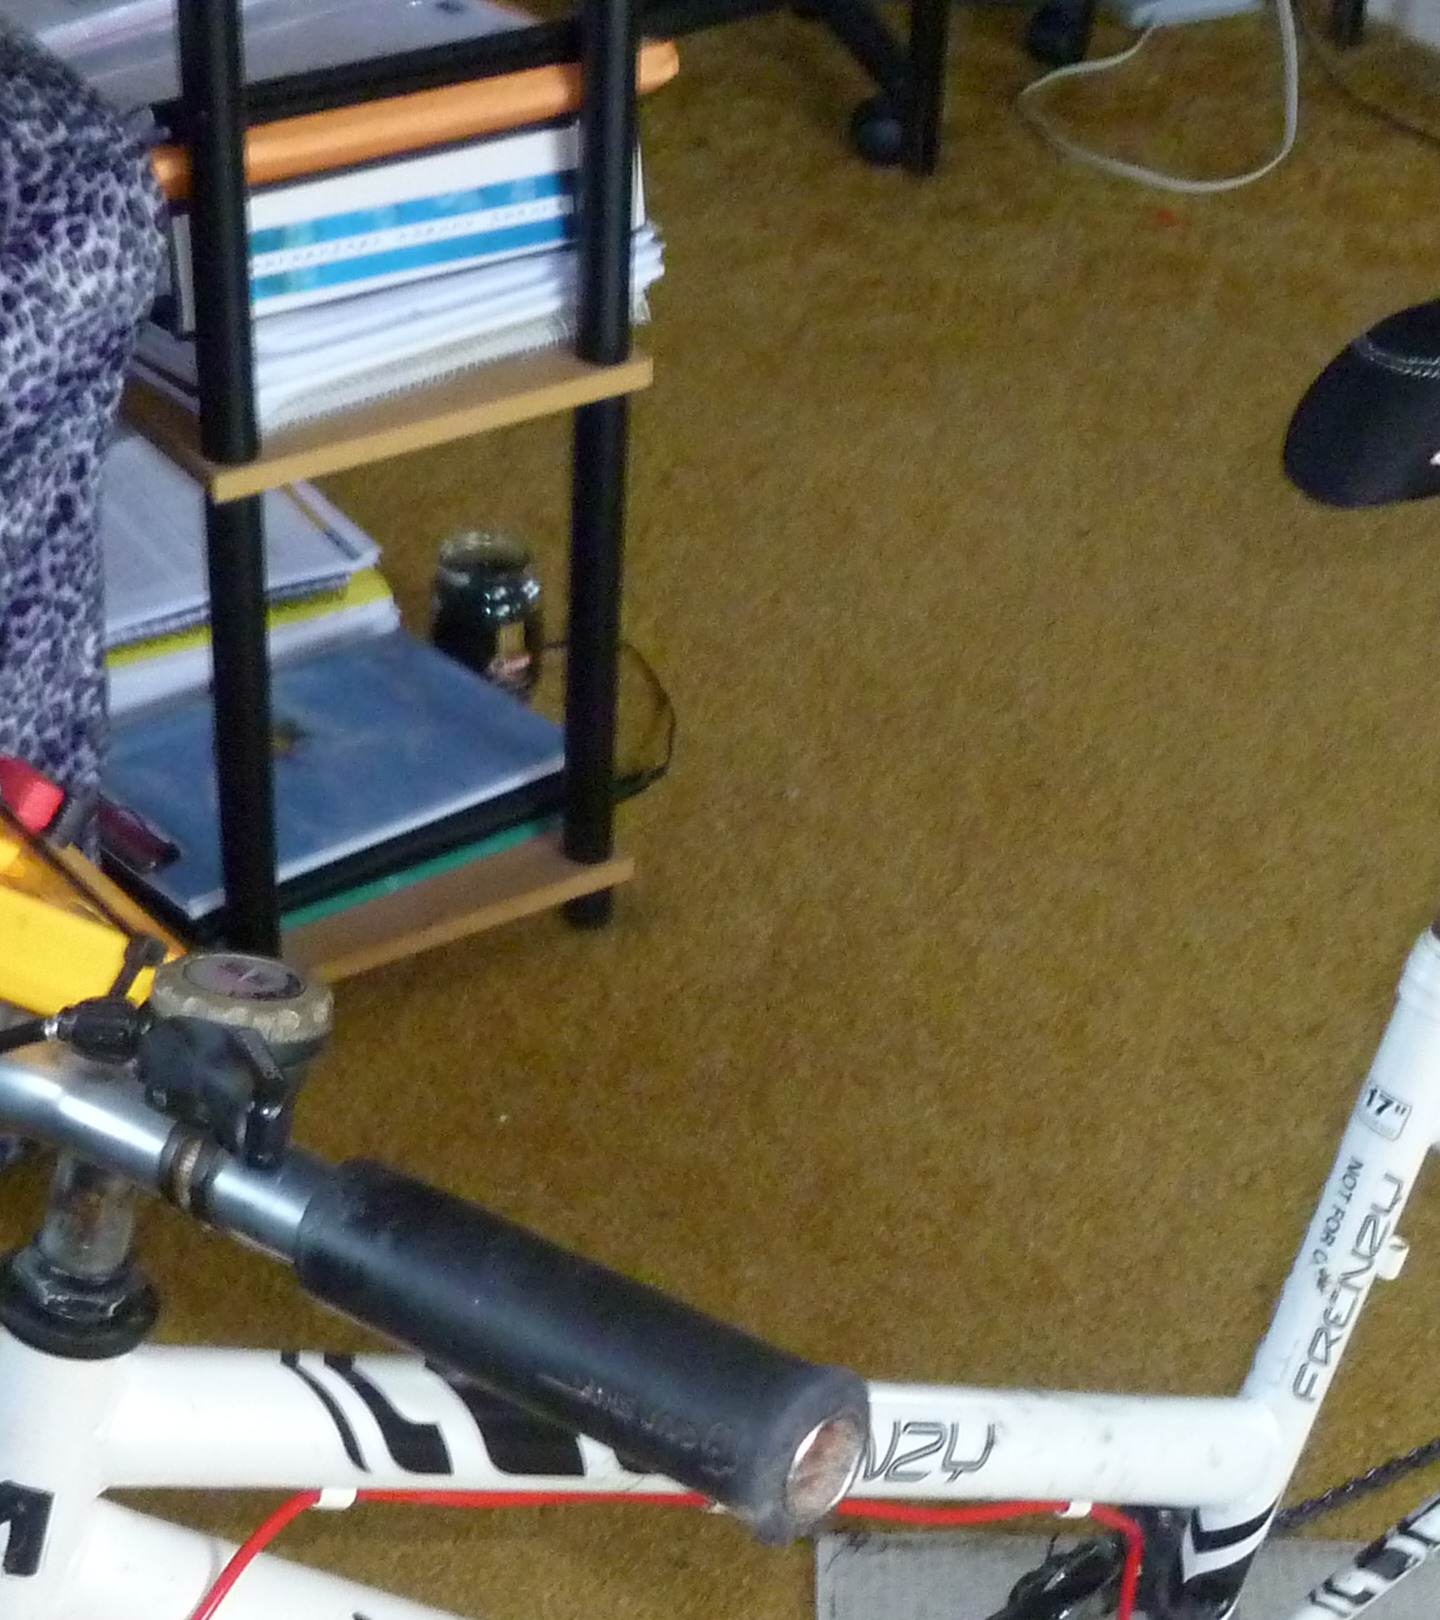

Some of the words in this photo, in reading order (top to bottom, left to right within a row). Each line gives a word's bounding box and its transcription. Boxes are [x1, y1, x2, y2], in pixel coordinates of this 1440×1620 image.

[1339, 1155, 1363, 1205] NOT
[1320, 1204, 1345, 1248] FOR
[1293, 1172, 1404, 1402] FRENZY
